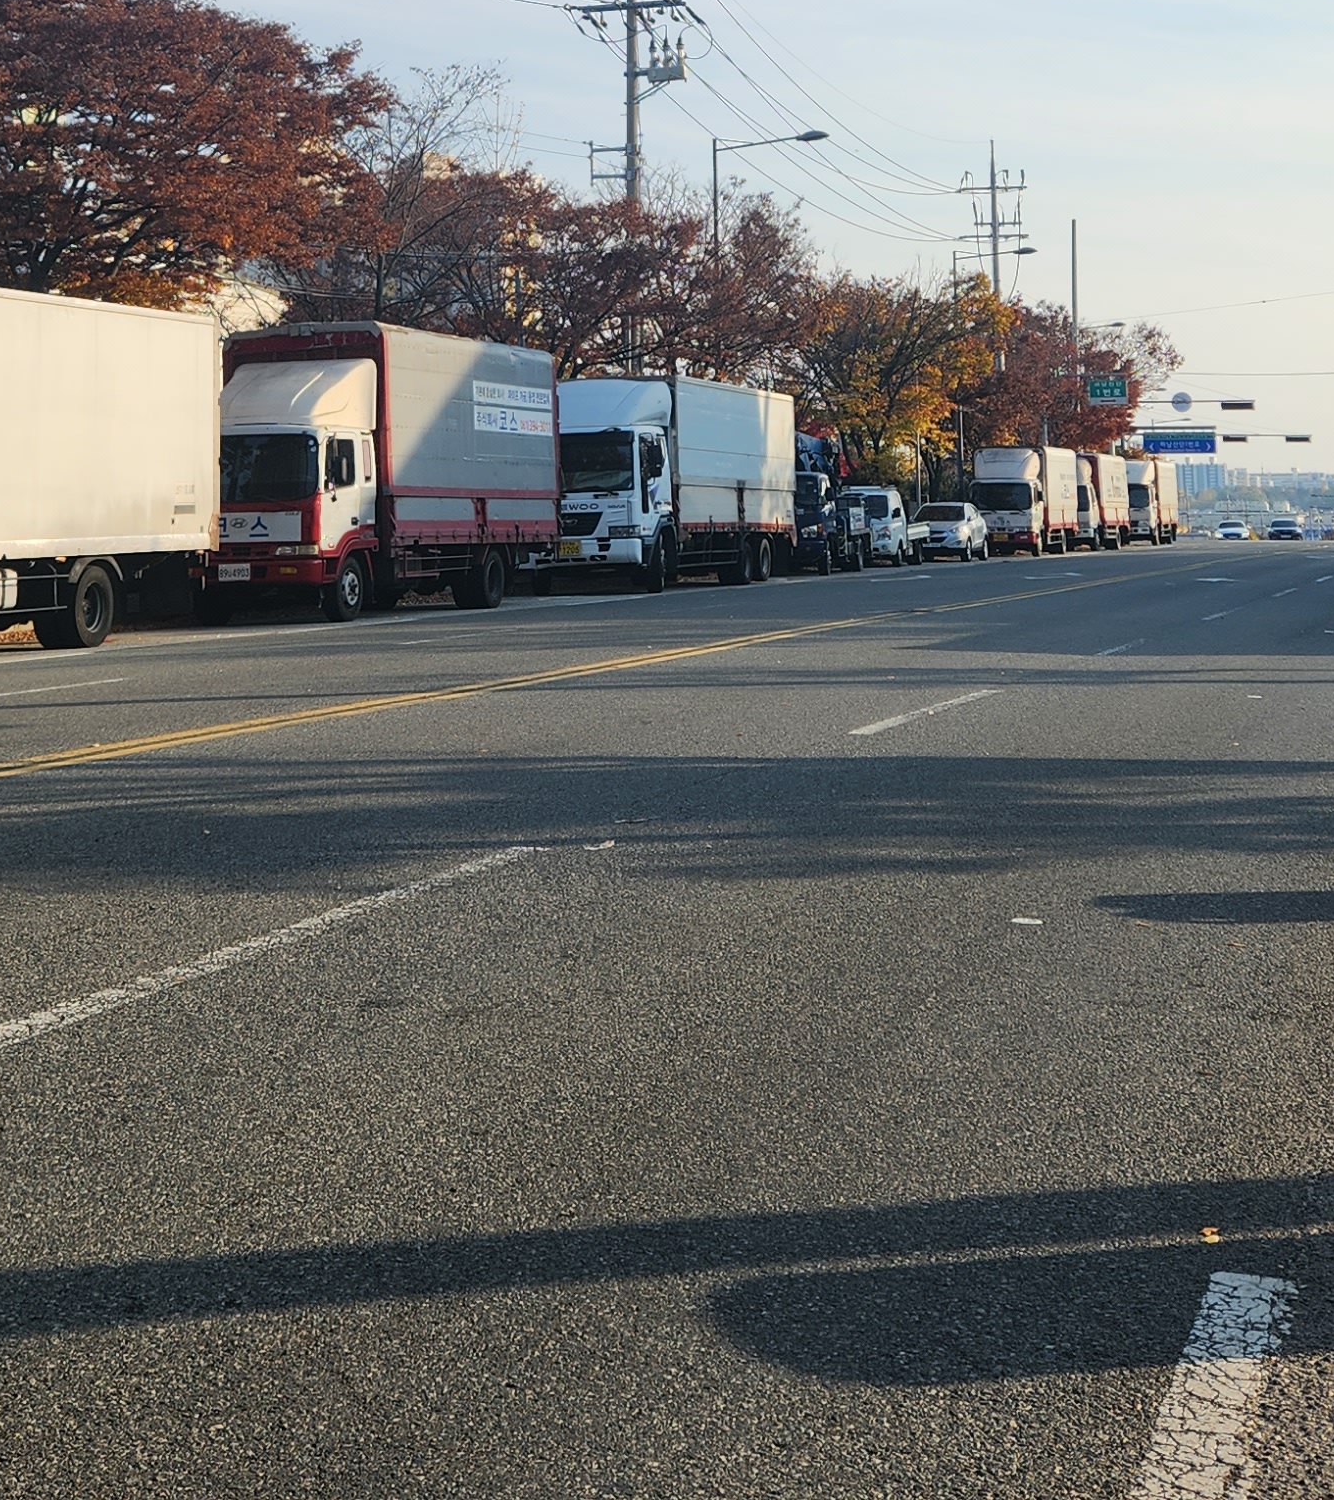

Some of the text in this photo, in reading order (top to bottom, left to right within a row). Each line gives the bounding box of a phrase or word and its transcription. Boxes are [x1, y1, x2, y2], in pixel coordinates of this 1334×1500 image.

[1096, 388, 1122, 397] 1번로
[476, 411, 498, 428] 주식회사
[499, 410, 518, 431] 코스
